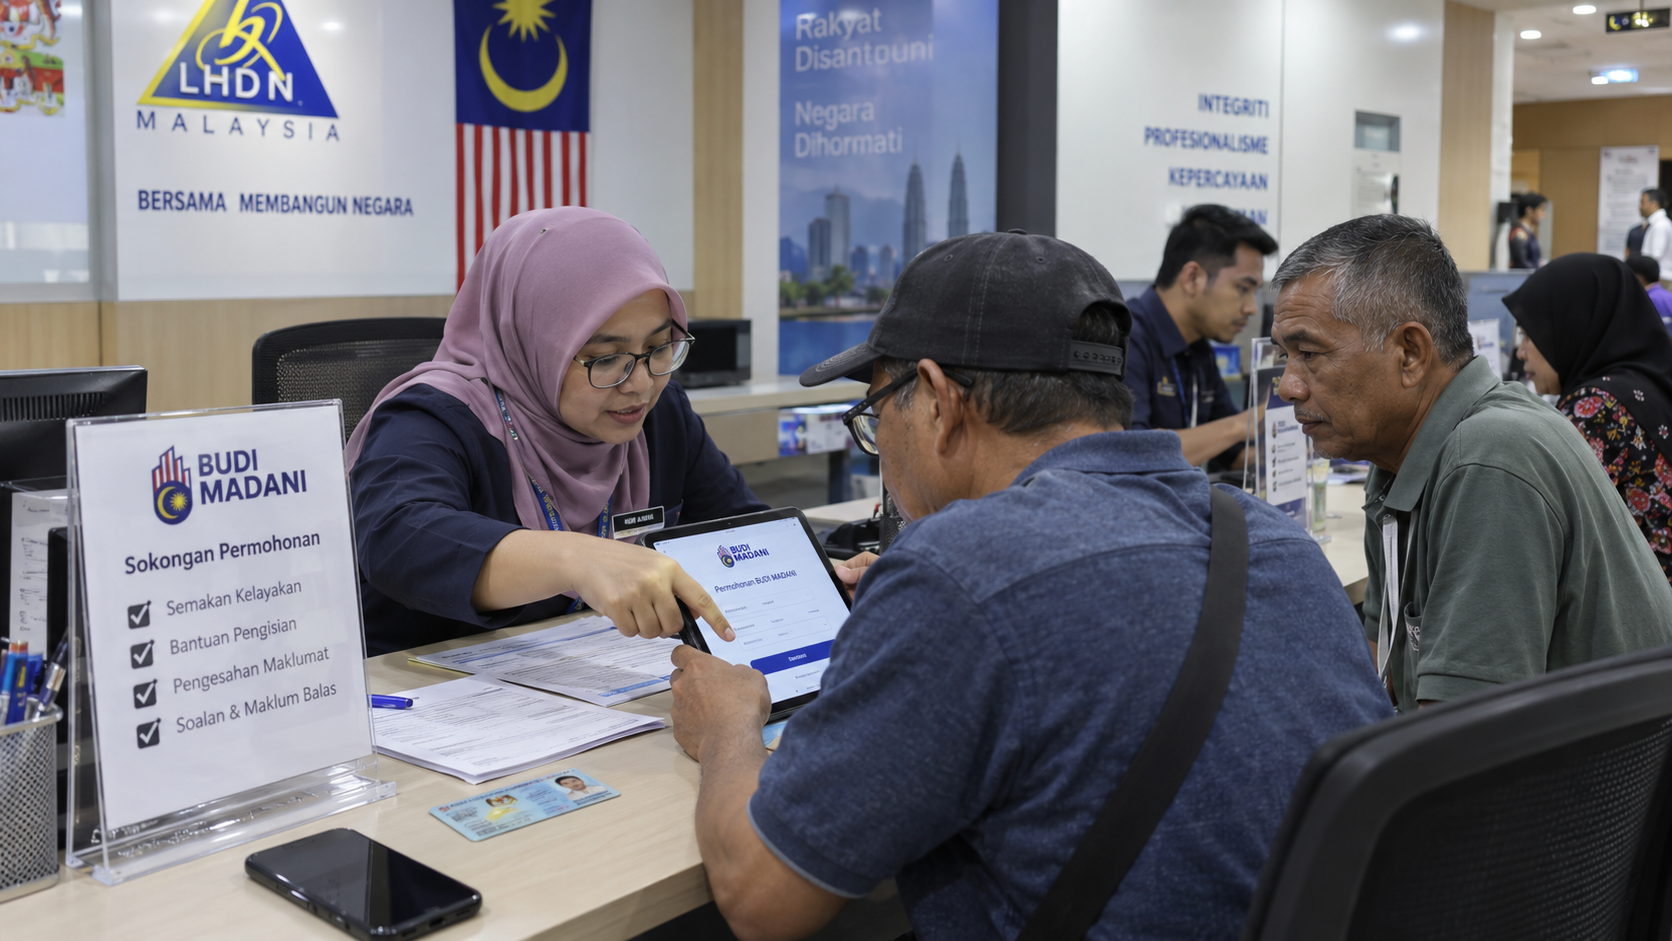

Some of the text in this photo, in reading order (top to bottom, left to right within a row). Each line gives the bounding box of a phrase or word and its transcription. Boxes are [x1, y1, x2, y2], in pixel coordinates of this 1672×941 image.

[796, 8, 882, 40] Rakyat
[180, 62, 293, 102] LHDN
[795, 101, 874, 131] Negara
[1198, 93, 1269, 119] INTEGRITI
[137, 110, 340, 141] MALAYSIA
[1144, 126, 1268, 154] PROFESIONALISME
[795, 127, 902, 158] Dihormati
[1168, 166, 1268, 190] KEPERCAYAAN
[138, 190, 414, 216] BERSAMA MEMBANGUN NEGARA
[198, 449, 258, 477] BUDI
[200, 470, 307, 505] MADANI
[124, 531, 321, 575] Sokongan Permohonan
[730, 543, 751, 554] BUDI
[733, 548, 769, 561] MADANI
[166, 580, 302, 616] Semakan Kelayakan
[170, 617, 297, 655] Bantuan Pengisian
[173, 646, 330, 694] Pengesahan Maklumat
[176, 682, 337, 733] Soalan & Maklum Balas
